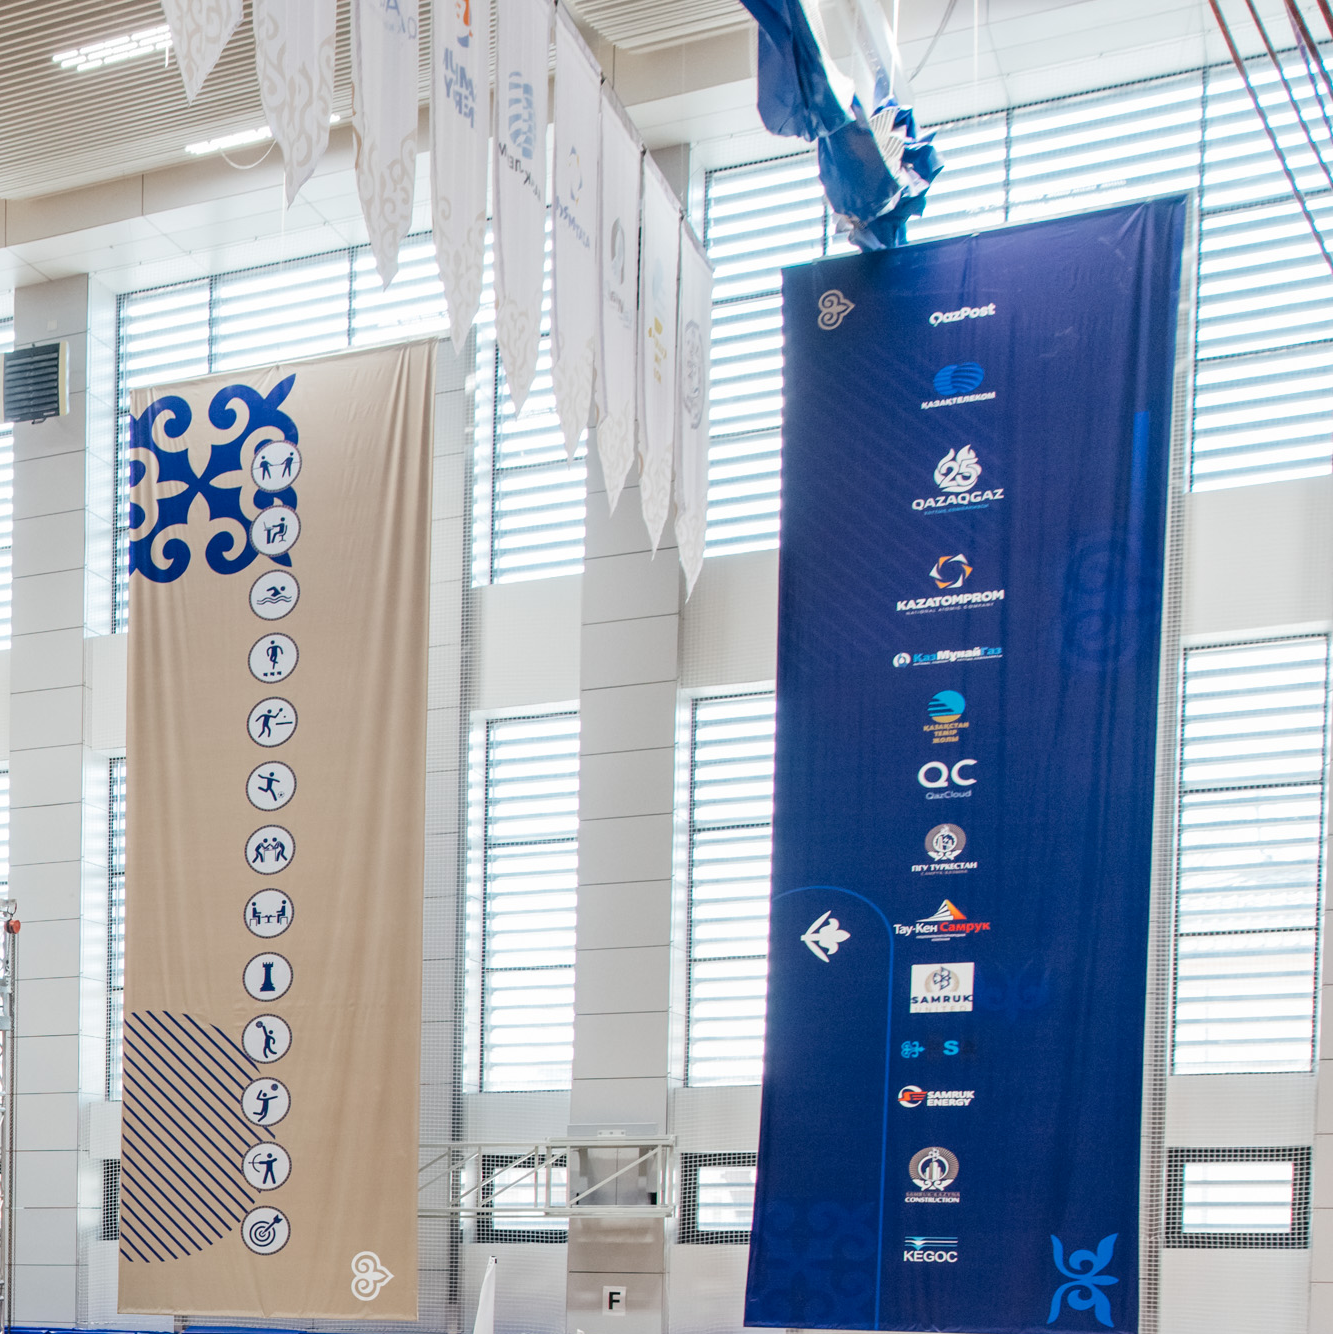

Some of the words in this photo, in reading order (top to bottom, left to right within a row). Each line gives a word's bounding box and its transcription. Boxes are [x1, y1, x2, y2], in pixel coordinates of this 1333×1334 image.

[929, 303, 996, 327] QazPost
[912, 488, 1005, 511] QAZAQGAZ
[896, 589, 1005, 611] KAZATOMPROM
[918, 759, 978, 788] QC
[925, 790, 972, 800] QazCloud
[929, 861, 978, 871] ТУРКЕСТАН
[893, 923, 938, 937] Тау-Кен
[939, 922, 991, 934] Самрук
[911, 994, 974, 1004] SAMRUK
[927, 1090, 975, 1099] SAMRUK
[927, 1098, 972, 1107] ENERGY
[904, 1196, 960, 1204] CONSTRUCTION
[903, 1251, 959, 1263] KEGOC
[609, 1292, 621, 1310] F
